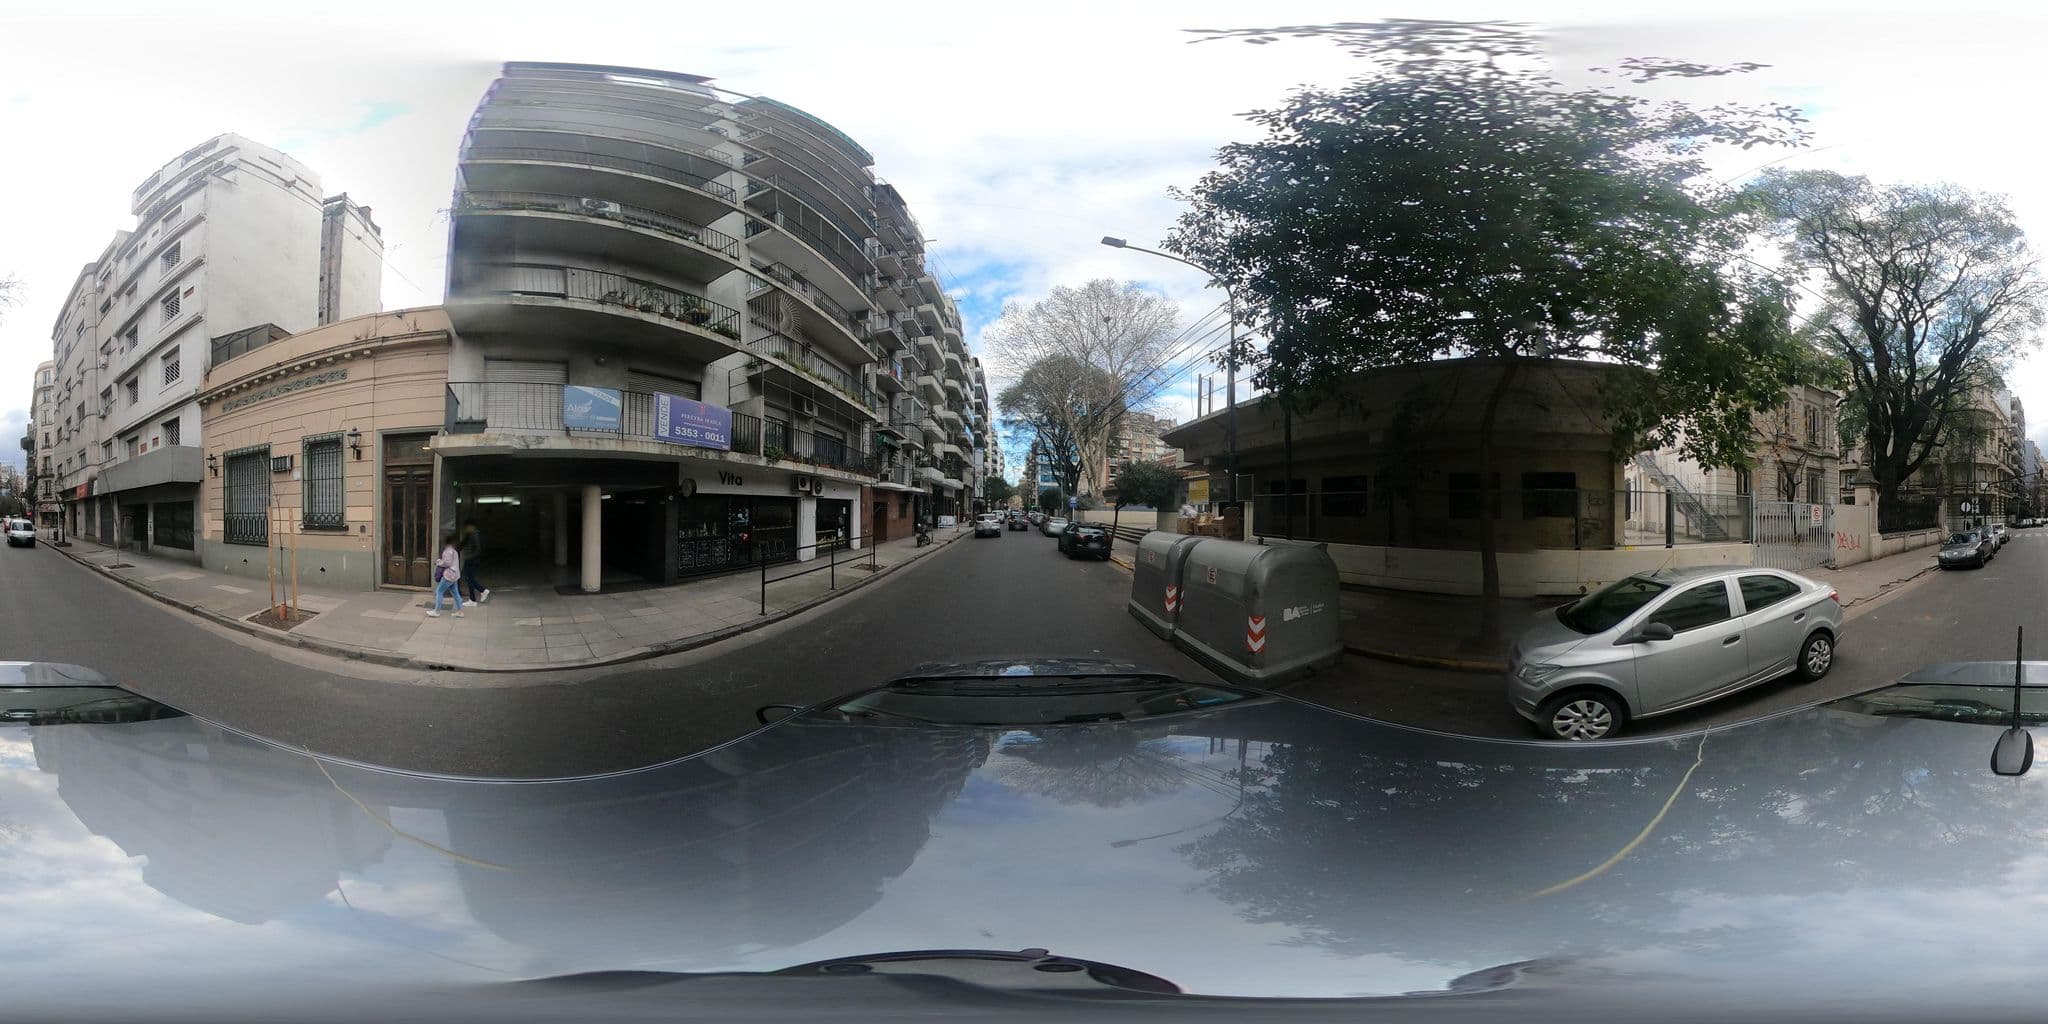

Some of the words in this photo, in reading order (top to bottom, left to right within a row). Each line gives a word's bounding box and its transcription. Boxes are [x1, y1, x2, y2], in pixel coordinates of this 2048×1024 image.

[675, 426, 698, 437] 5353
[705, 431, 726, 443] 0011
[719, 470, 743, 486] Vita
